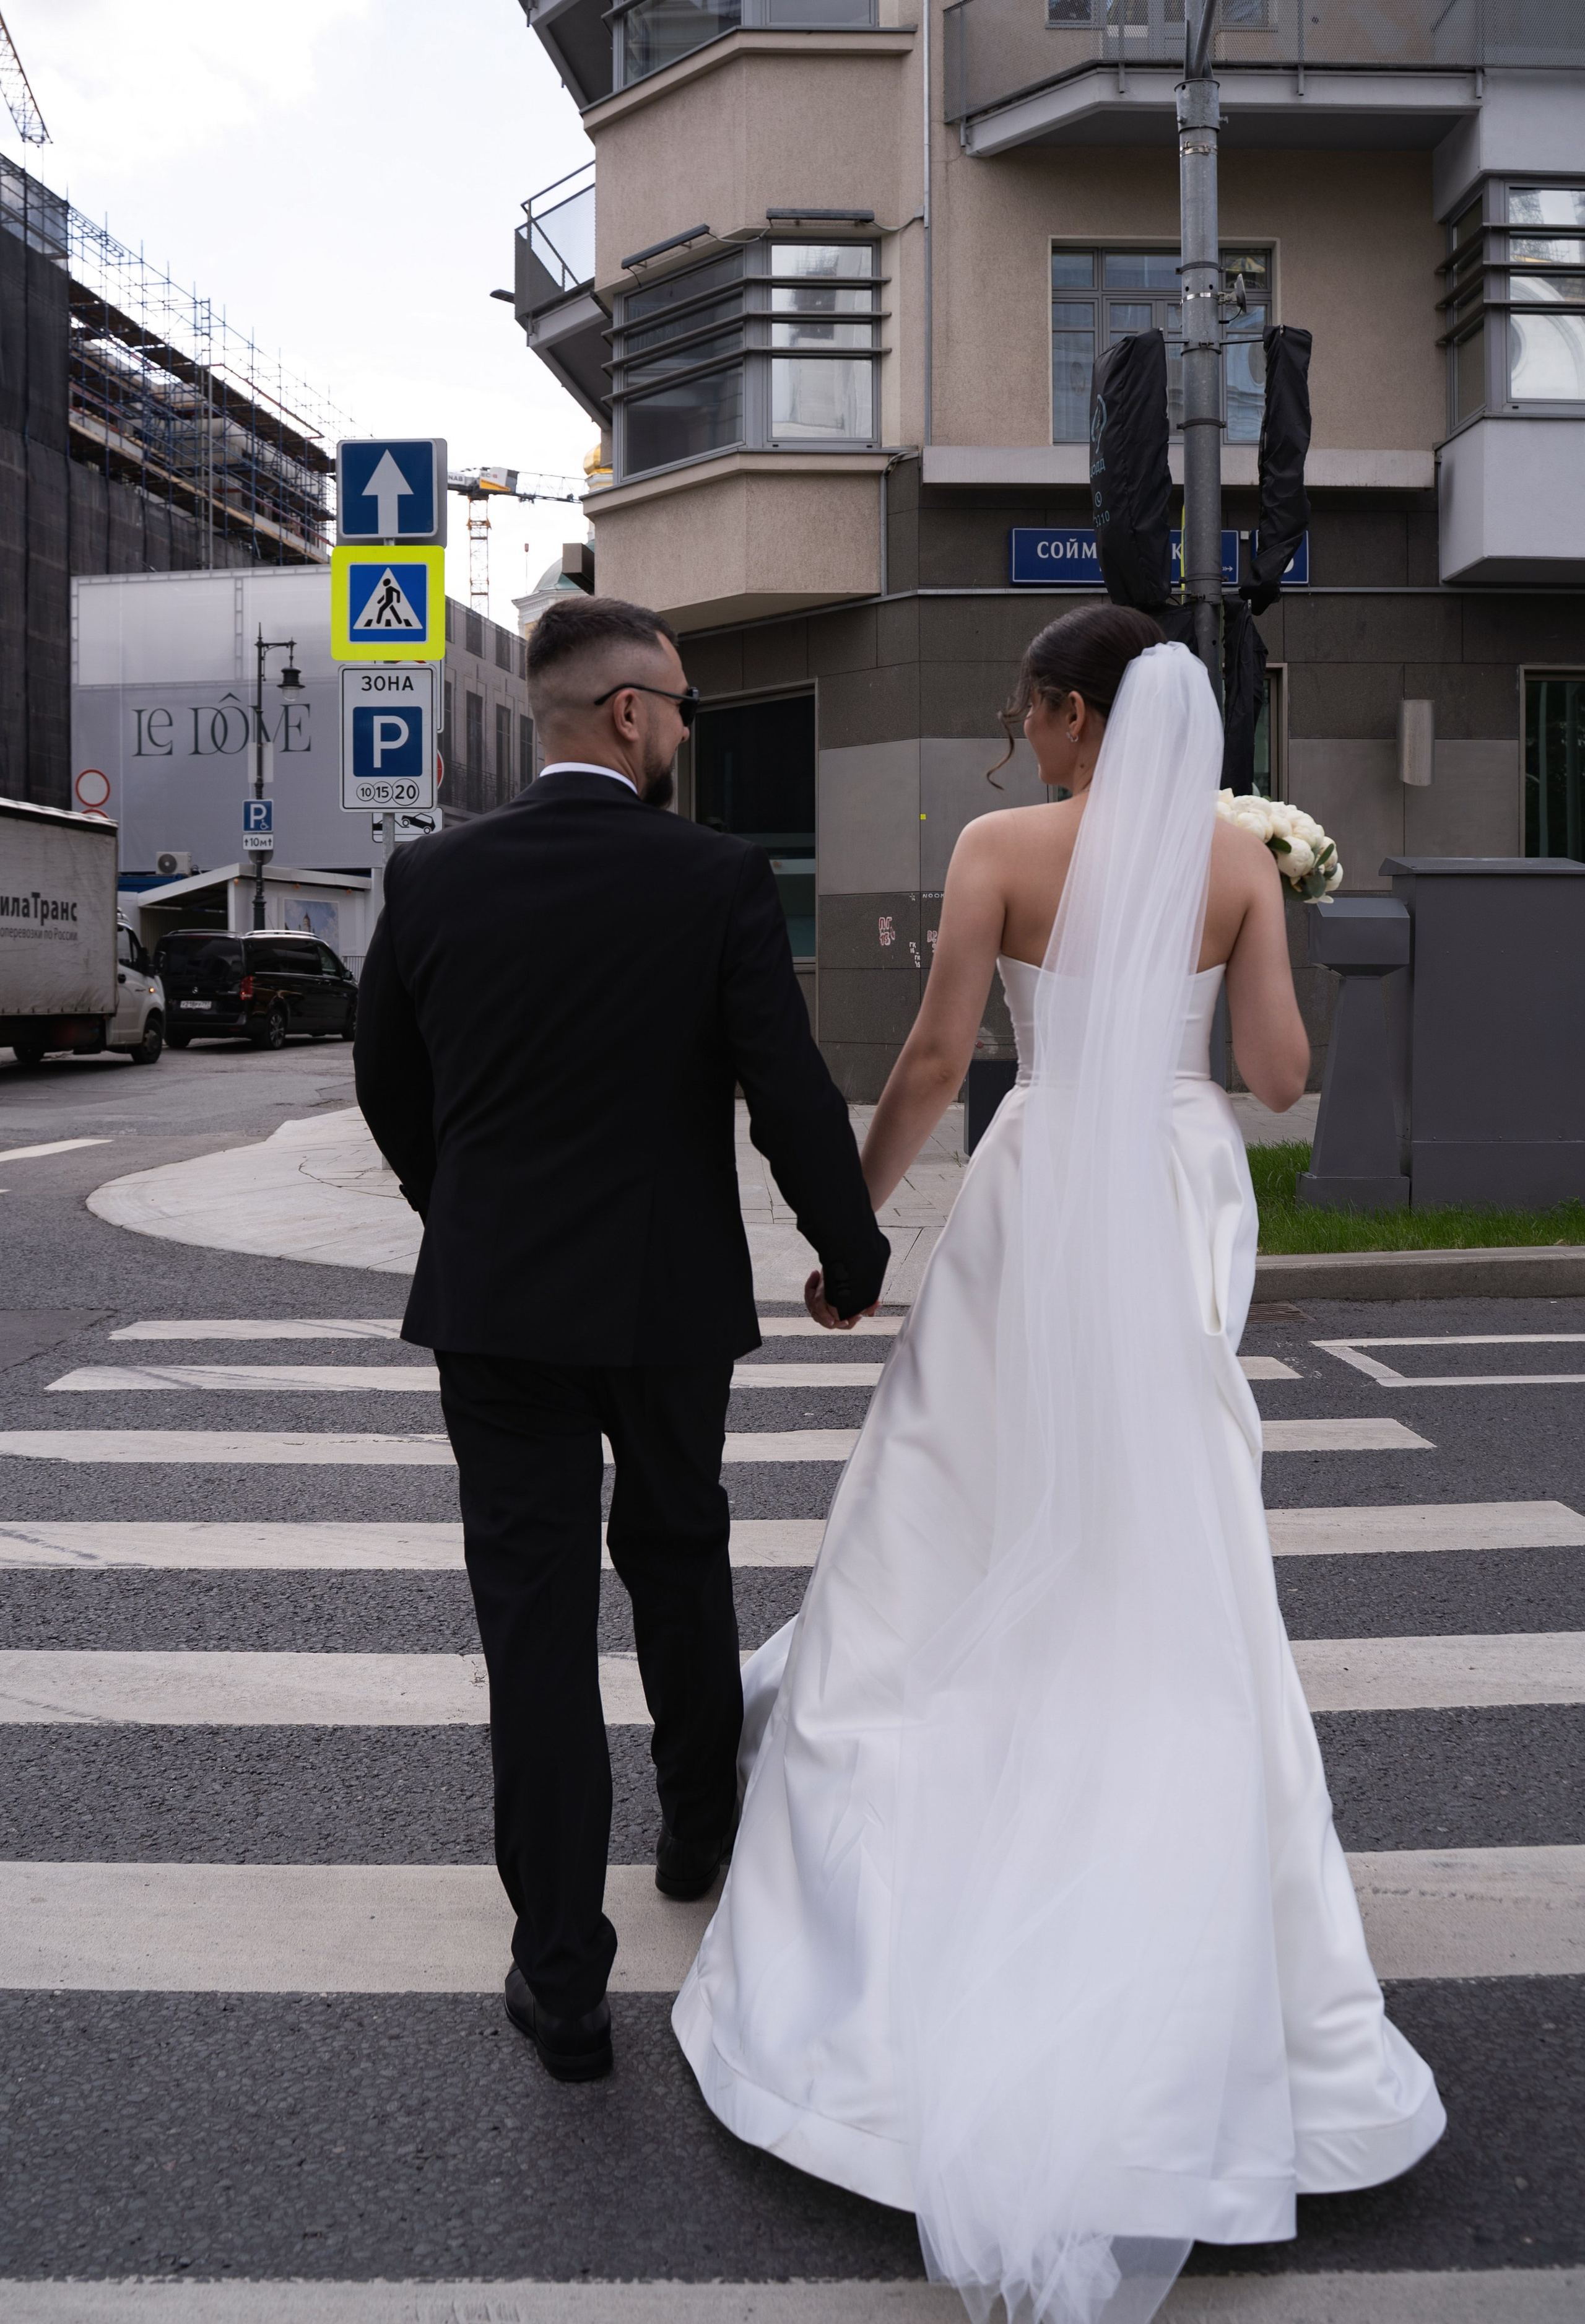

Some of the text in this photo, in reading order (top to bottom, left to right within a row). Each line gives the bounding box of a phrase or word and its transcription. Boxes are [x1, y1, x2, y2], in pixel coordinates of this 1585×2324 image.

[1090, 458, 1106, 479] ОДД
[361, 676, 414, 691] ЗОНА
[373, 715, 409, 768] P
[360, 785, 416, 799] 10 15 20
[250, 803, 267, 829] P
